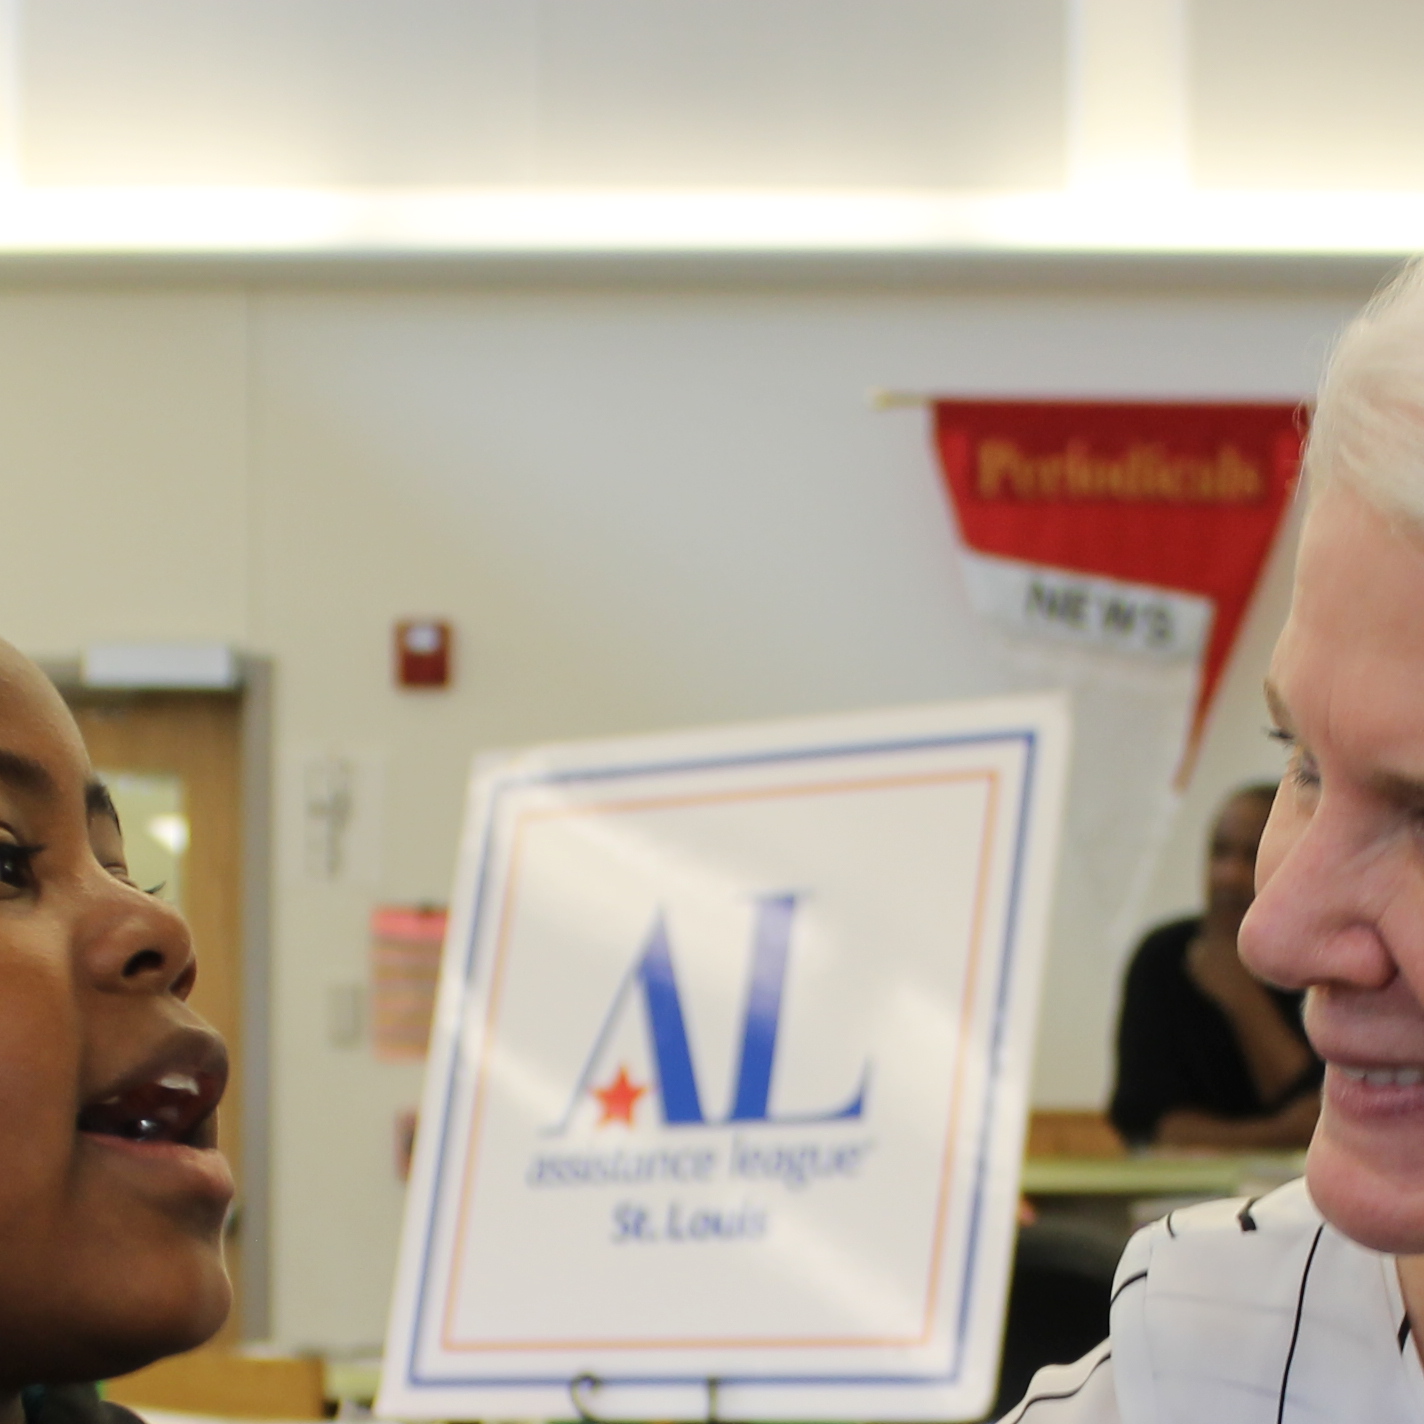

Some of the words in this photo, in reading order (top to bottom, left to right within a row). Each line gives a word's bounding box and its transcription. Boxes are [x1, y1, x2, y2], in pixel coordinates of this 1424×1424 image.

[978, 438, 1262, 502] Periodicals
[1026, 574, 1176, 646] NEWS
[538, 888, 872, 1138] AL
[668, 1196, 768, 1242] Louis
